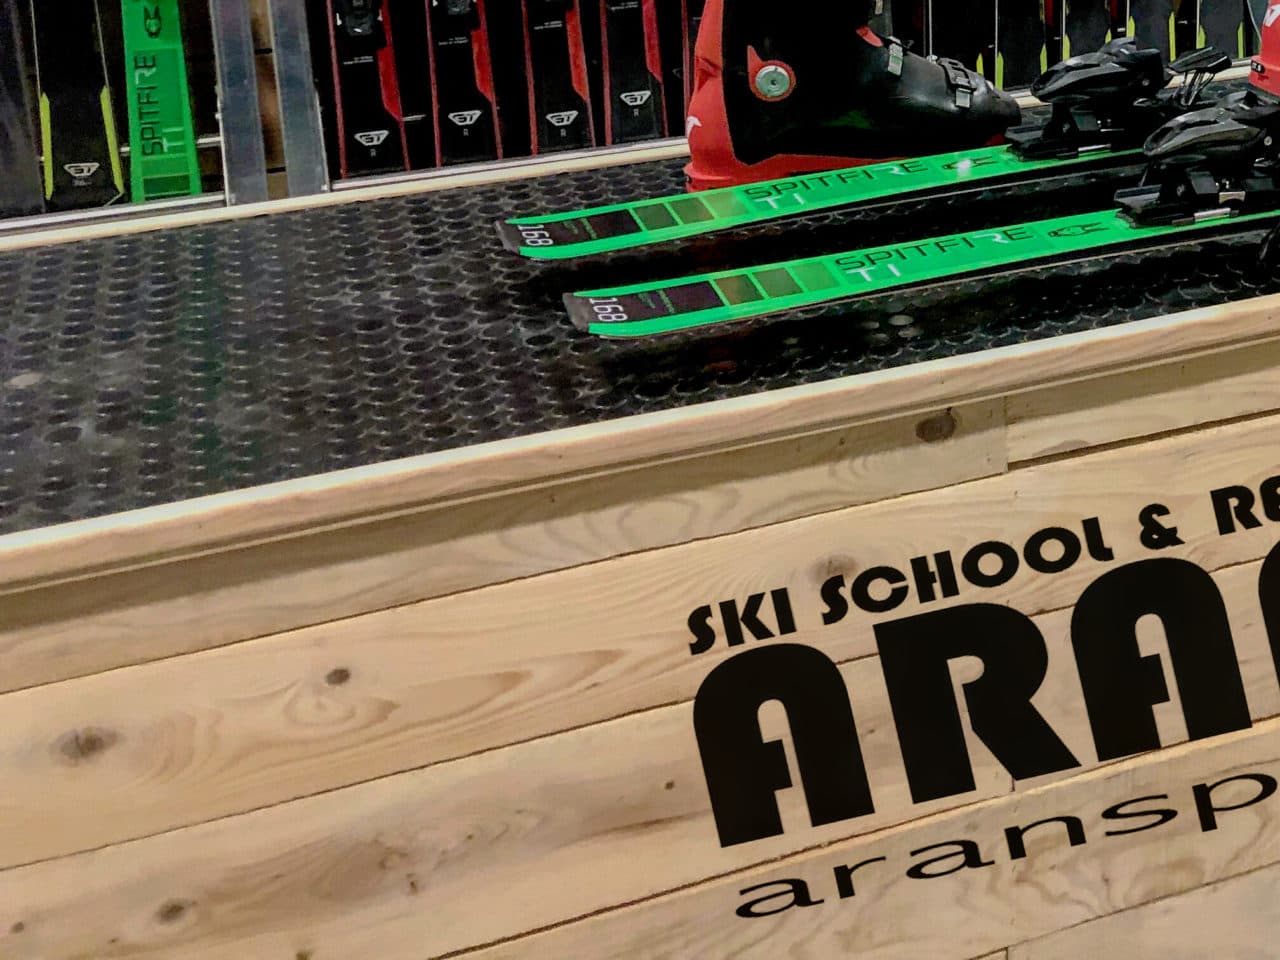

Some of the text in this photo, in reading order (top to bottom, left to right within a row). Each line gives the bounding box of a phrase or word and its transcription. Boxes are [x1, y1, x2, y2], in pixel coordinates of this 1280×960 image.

[133, 54, 164, 157] SPITFIRE
[743, 159, 929, 200] SPITFIRE
[517, 224, 554, 247] 168
[834, 226, 1034, 272] SPITFIRE
[588, 296, 628, 323] 168
[688, 586, 799, 657] SKI
[820, 516, 1115, 625] SCHOOL
[1139, 503, 1186, 550] &
